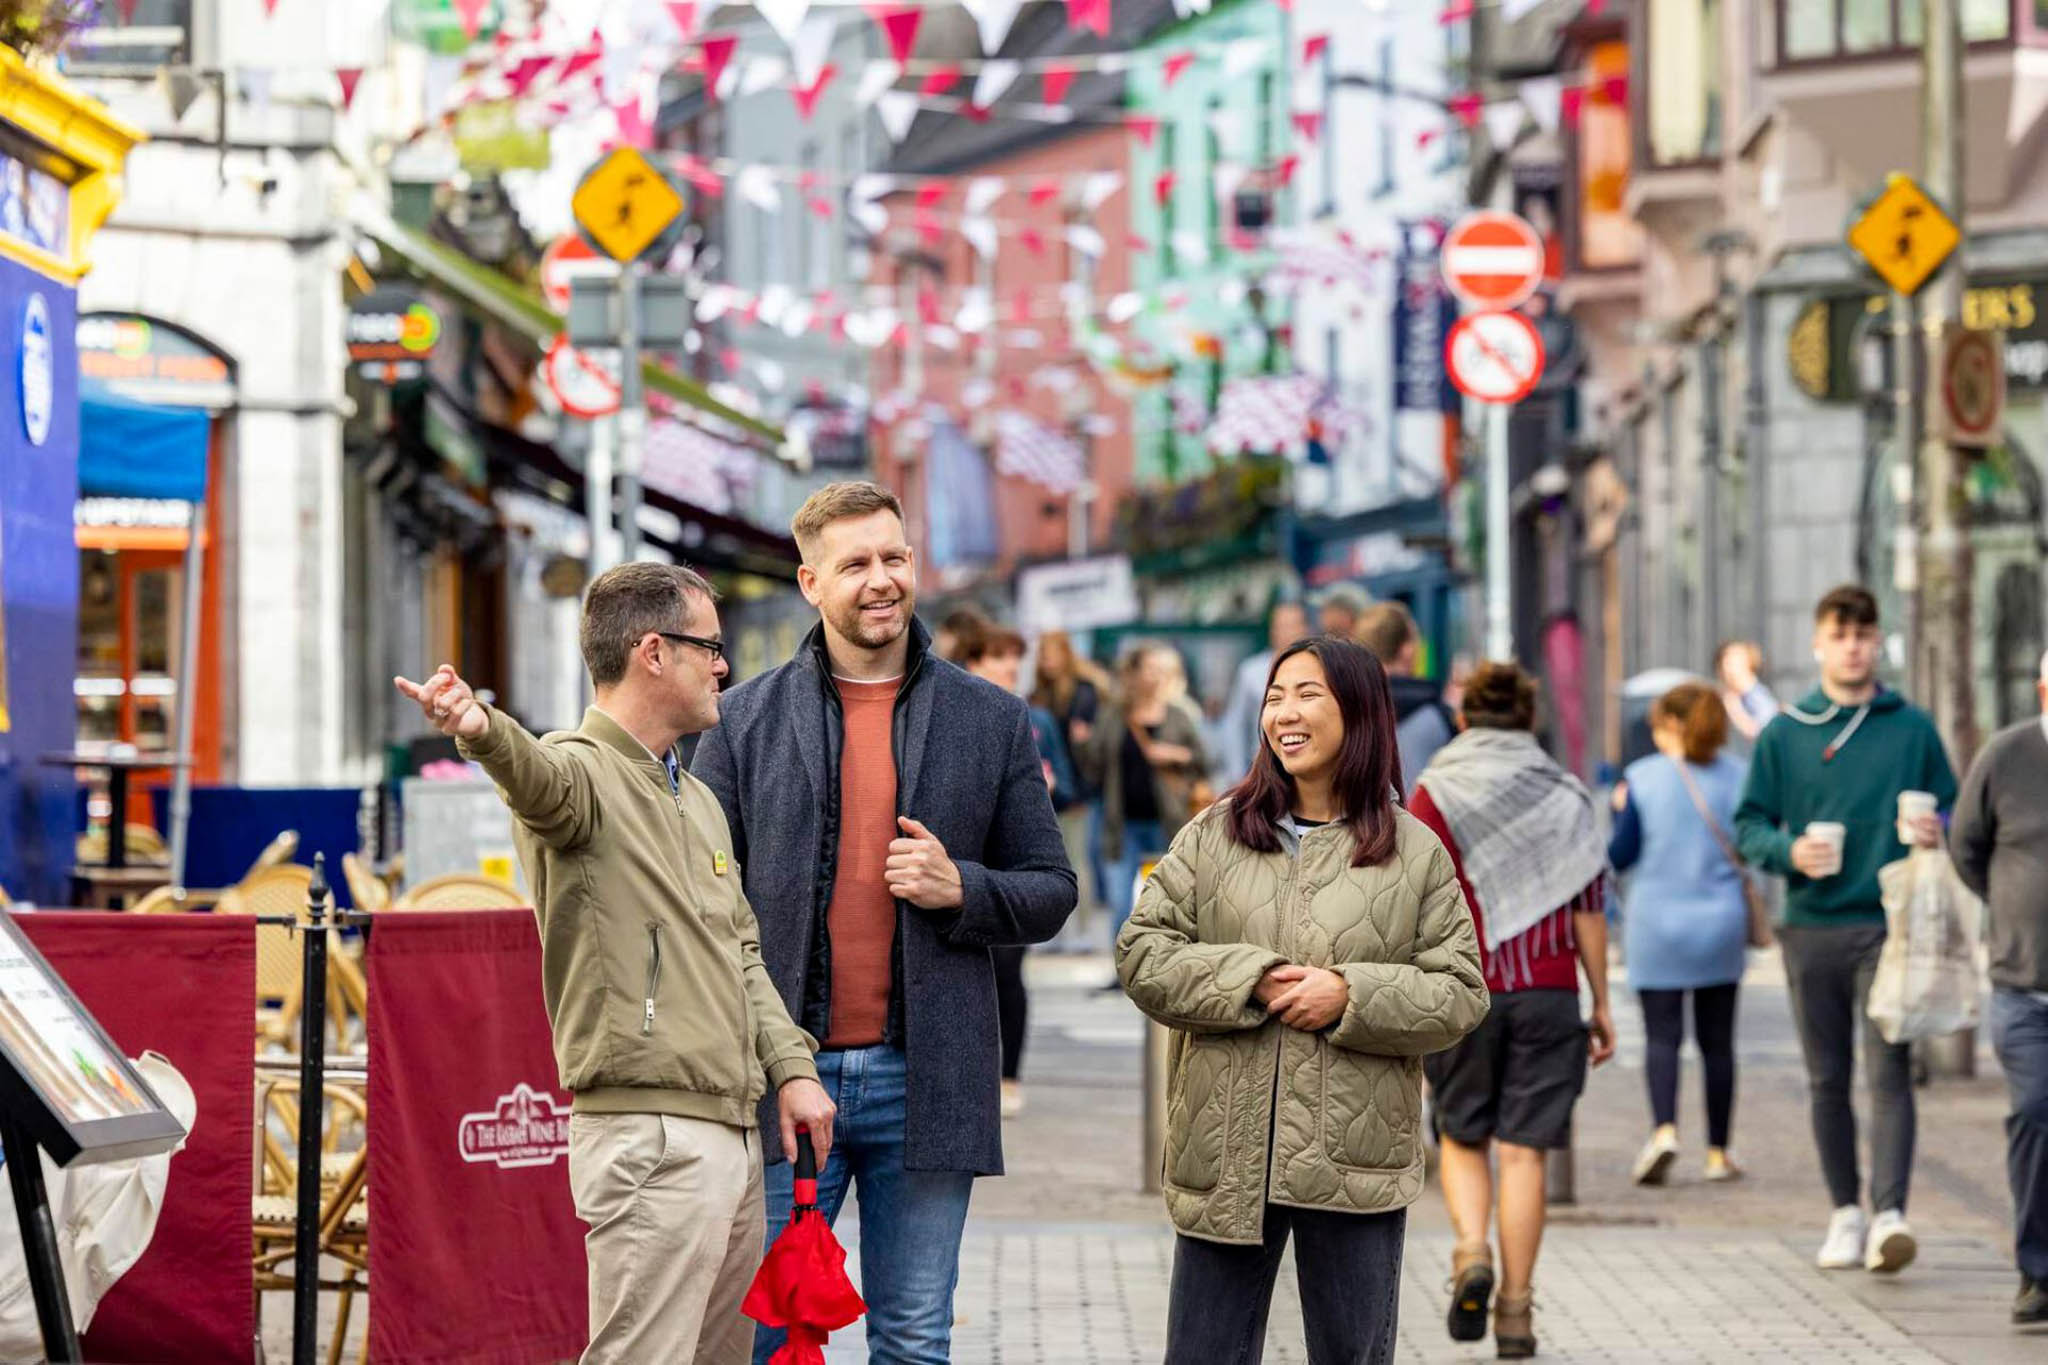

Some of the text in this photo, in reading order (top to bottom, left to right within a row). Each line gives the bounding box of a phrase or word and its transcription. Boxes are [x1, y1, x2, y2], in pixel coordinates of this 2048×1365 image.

[1963, 284, 2037, 330] ERS
[476, 1123, 496, 1148] THE
[528, 1119, 556, 1144] WINE
